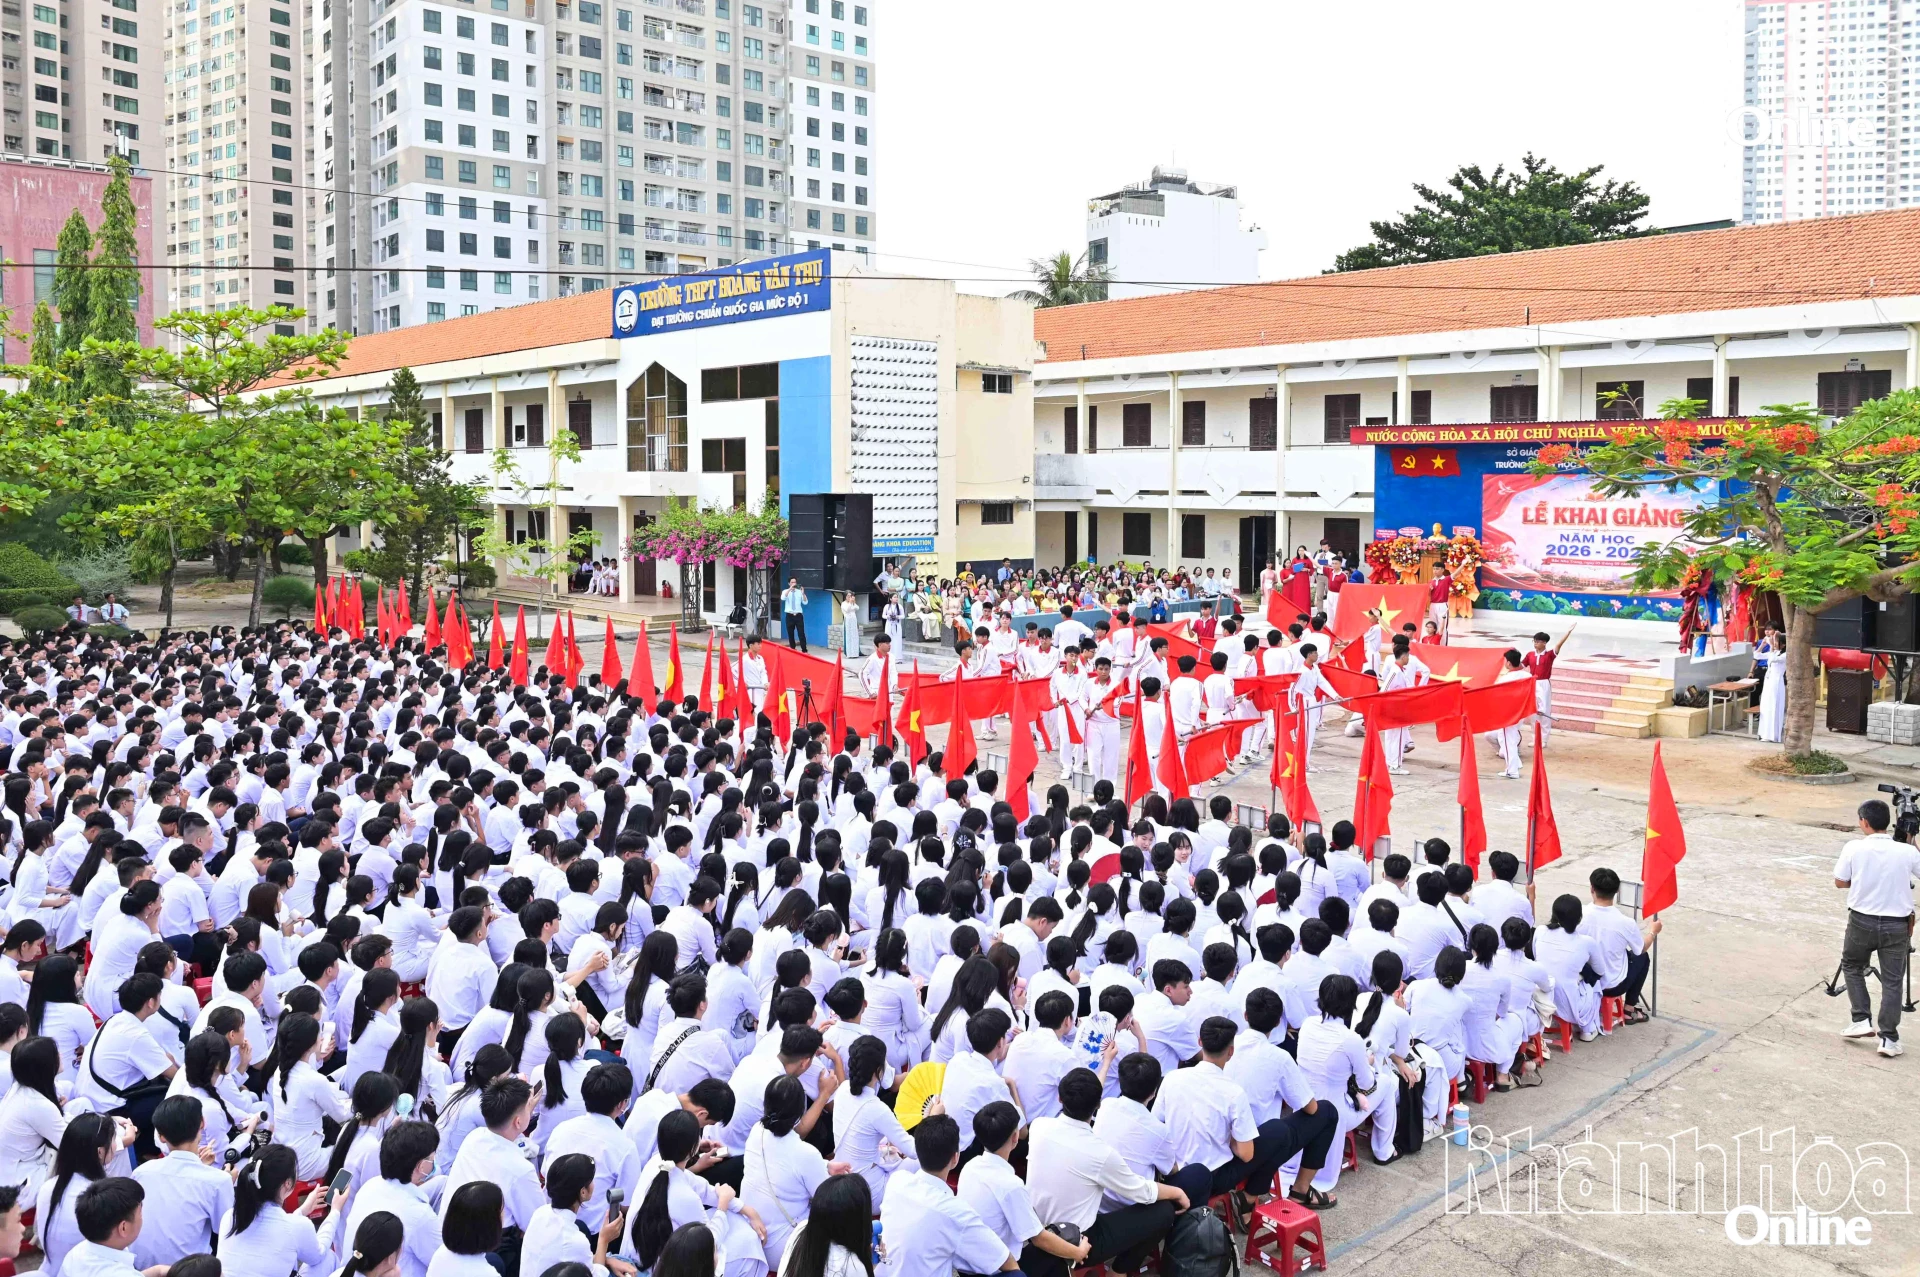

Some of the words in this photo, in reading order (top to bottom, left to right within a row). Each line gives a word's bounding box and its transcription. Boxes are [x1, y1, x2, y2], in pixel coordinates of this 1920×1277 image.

[639, 282, 683, 311] TRƯỜNG
[685, 281, 716, 304] THPT
[718, 268, 762, 299] HOÀNG
[763, 261, 791, 290] VĂN
[793, 259, 823, 286] THỤ
[651, 316, 664, 328] ĐẠT
[666, 310, 694, 325] TRƯỜNG
[695, 302, 722, 320] CHUẨN
[724, 298, 748, 317] QUỐC
[749, 299, 765, 313] GIA
[766, 294, 786, 310] MỨC
[787, 293, 802, 309] ĐỘ
[803, 293, 809, 305] 1
[1366, 429, 1398, 442] NƯỚC
[1401, 429, 1436, 443] CỘNG
[1439, 427, 1467, 441] HÒA
[1470, 428, 1491, 440] XÃ
[1494, 427, 1518, 442] HỘI
[1523, 425, 1552, 439] CHỦ
[1557, 424, 1606, 438] NGHĨA
[1507, 448, 1518, 457] SỞ
[1522, 501, 1548, 525] LỄ
[1553, 506, 1607, 527] KHAI
[1612, 503, 1685, 528] GIẢNG
[1559, 533, 1595, 544] NĂM
[1601, 535, 1635, 546] HỌC
[1546, 544, 1591, 557] 2026
